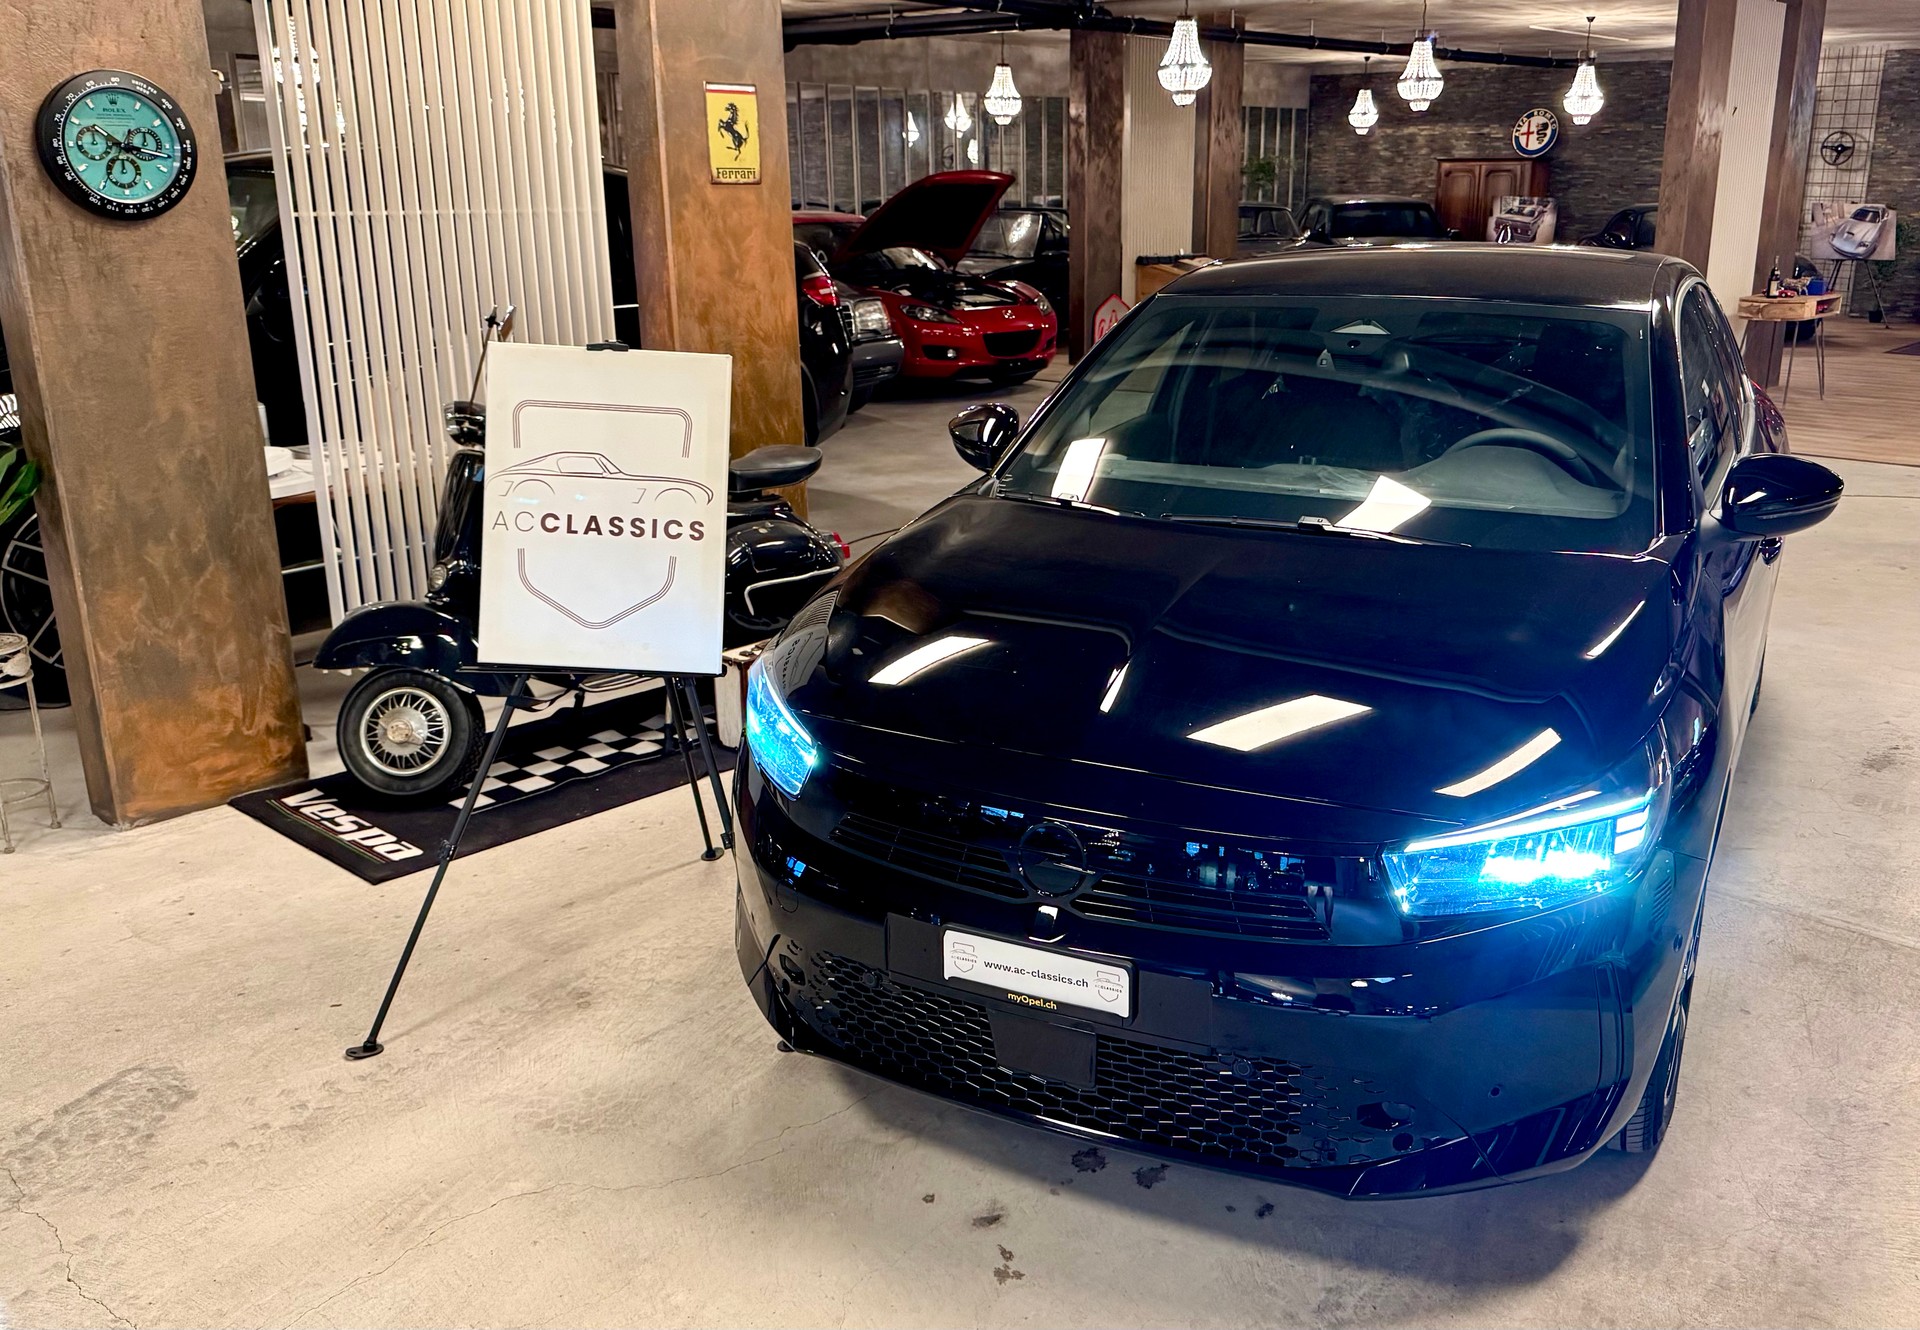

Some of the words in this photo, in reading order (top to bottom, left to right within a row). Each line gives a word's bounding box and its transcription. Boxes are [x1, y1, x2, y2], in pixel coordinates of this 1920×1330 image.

[1534, 110, 1557, 129] ROMEO
[716, 168, 756, 179] Ferrari
[492, 510, 705, 541] ACCLASSICS
[281, 788, 424, 861] Vespa
[984, 960, 1089, 988] www.ac-classics.ch
[1007, 992, 1057, 1010] myOpel.ch
